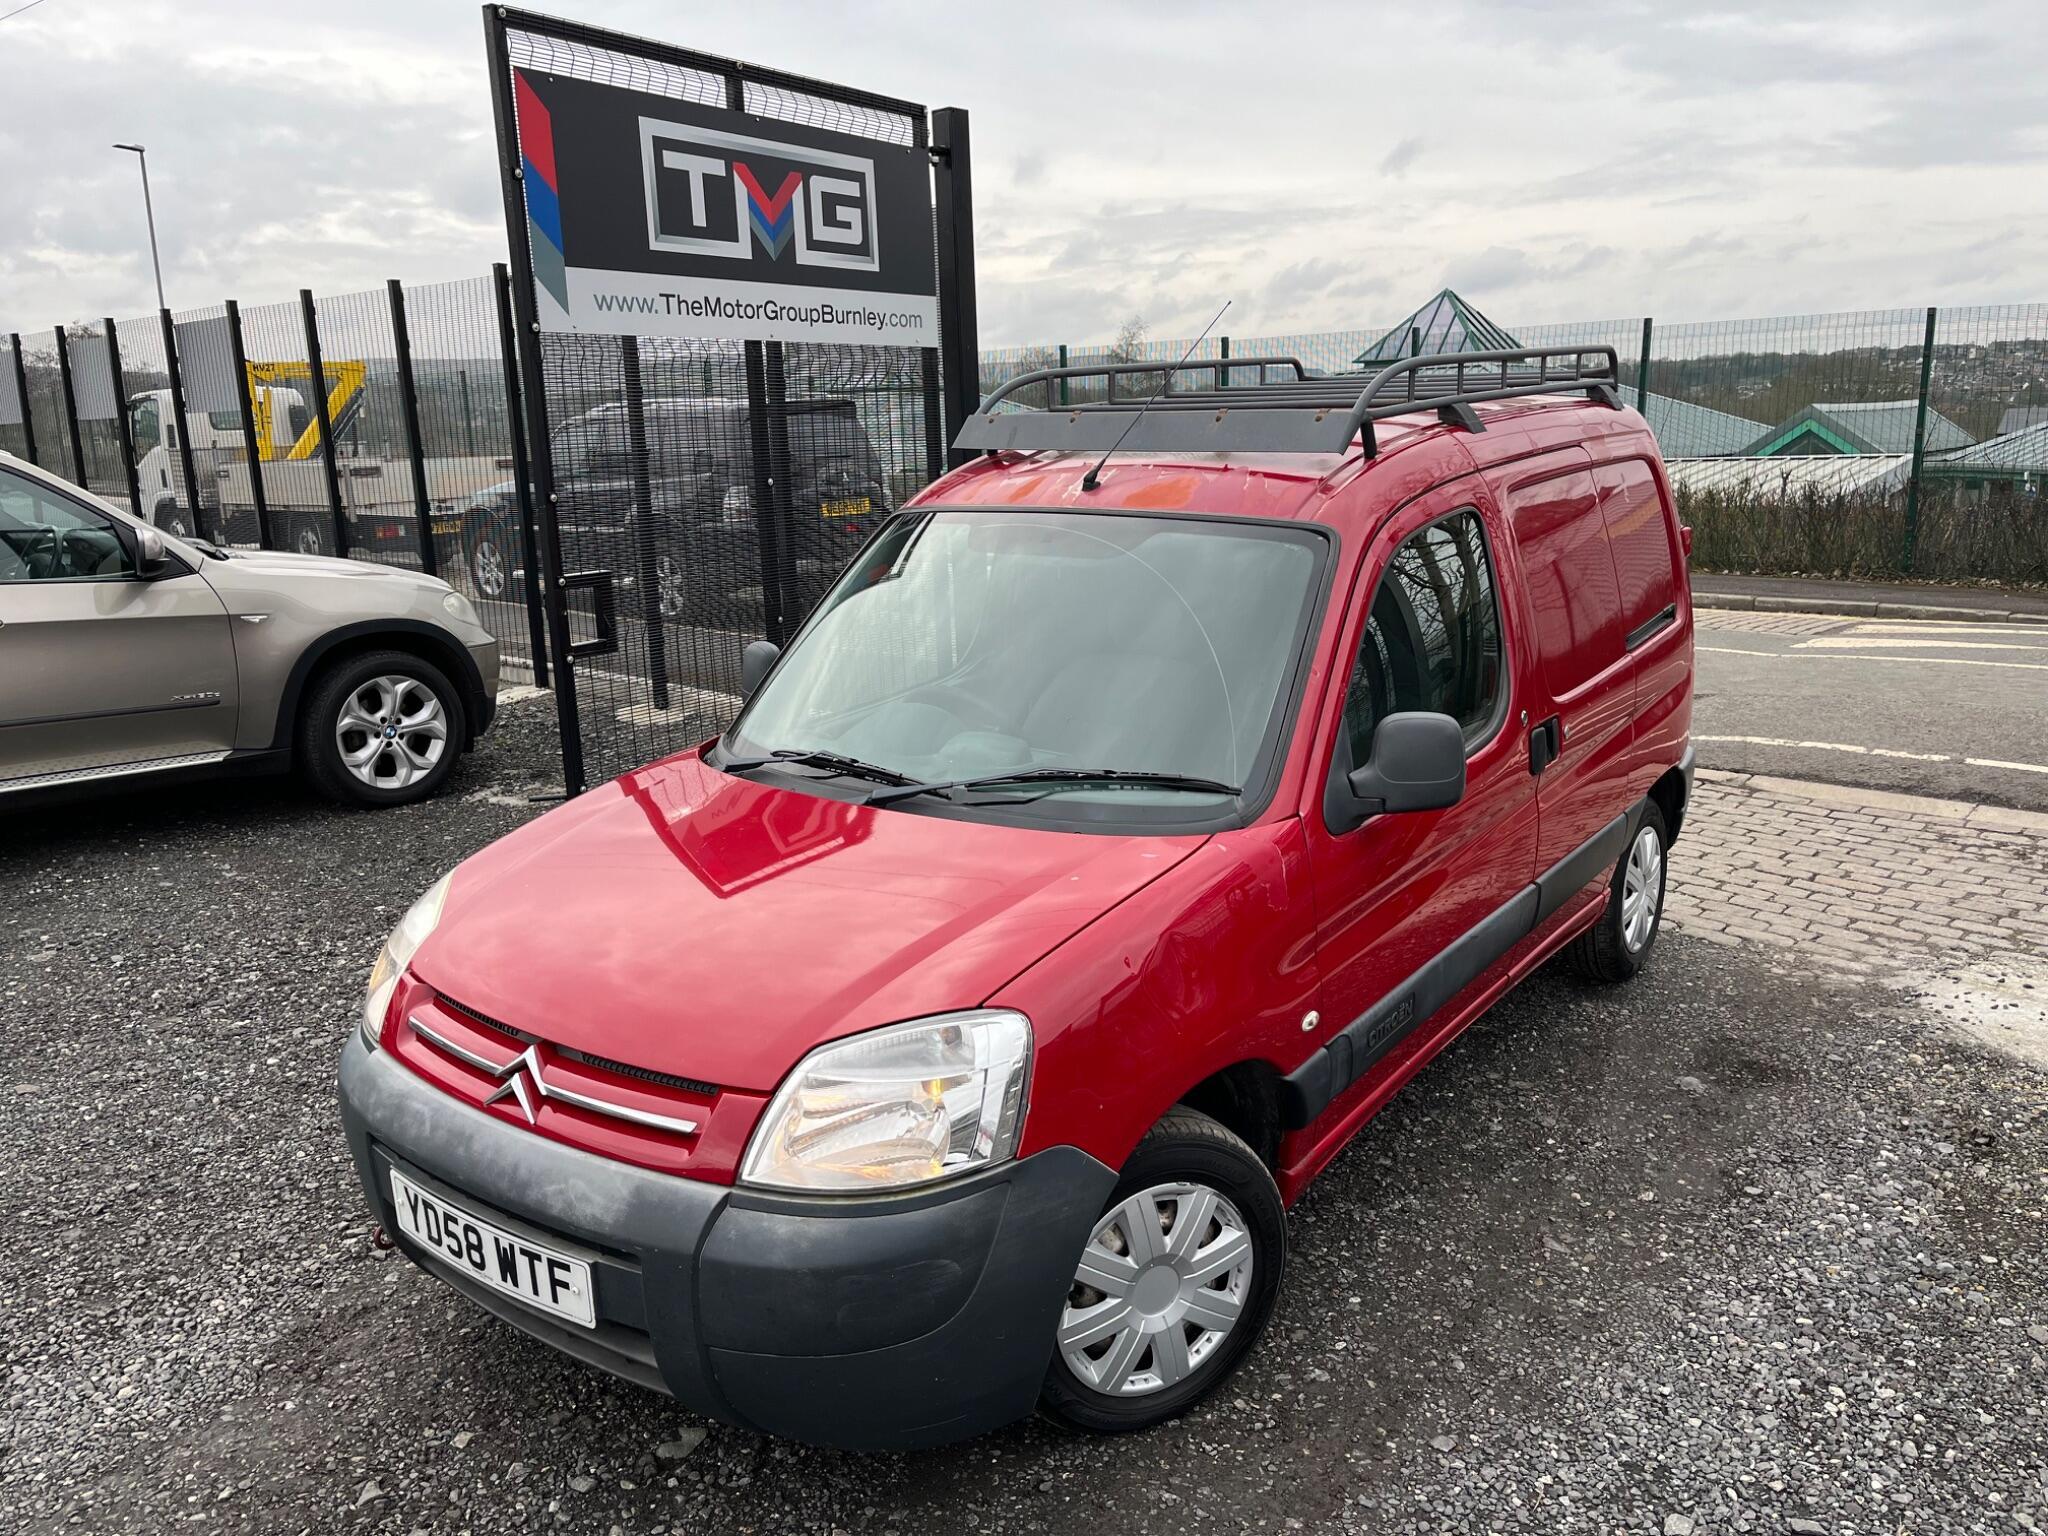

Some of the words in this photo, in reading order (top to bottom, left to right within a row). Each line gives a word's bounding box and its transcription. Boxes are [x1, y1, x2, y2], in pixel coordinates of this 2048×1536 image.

[661, 149, 863, 262] TMG
[593, 292, 924, 330] www.TheMotorGroupBurnley.com
[404, 1186, 486, 1271] YD58
[494, 1236, 572, 1305] WTF
